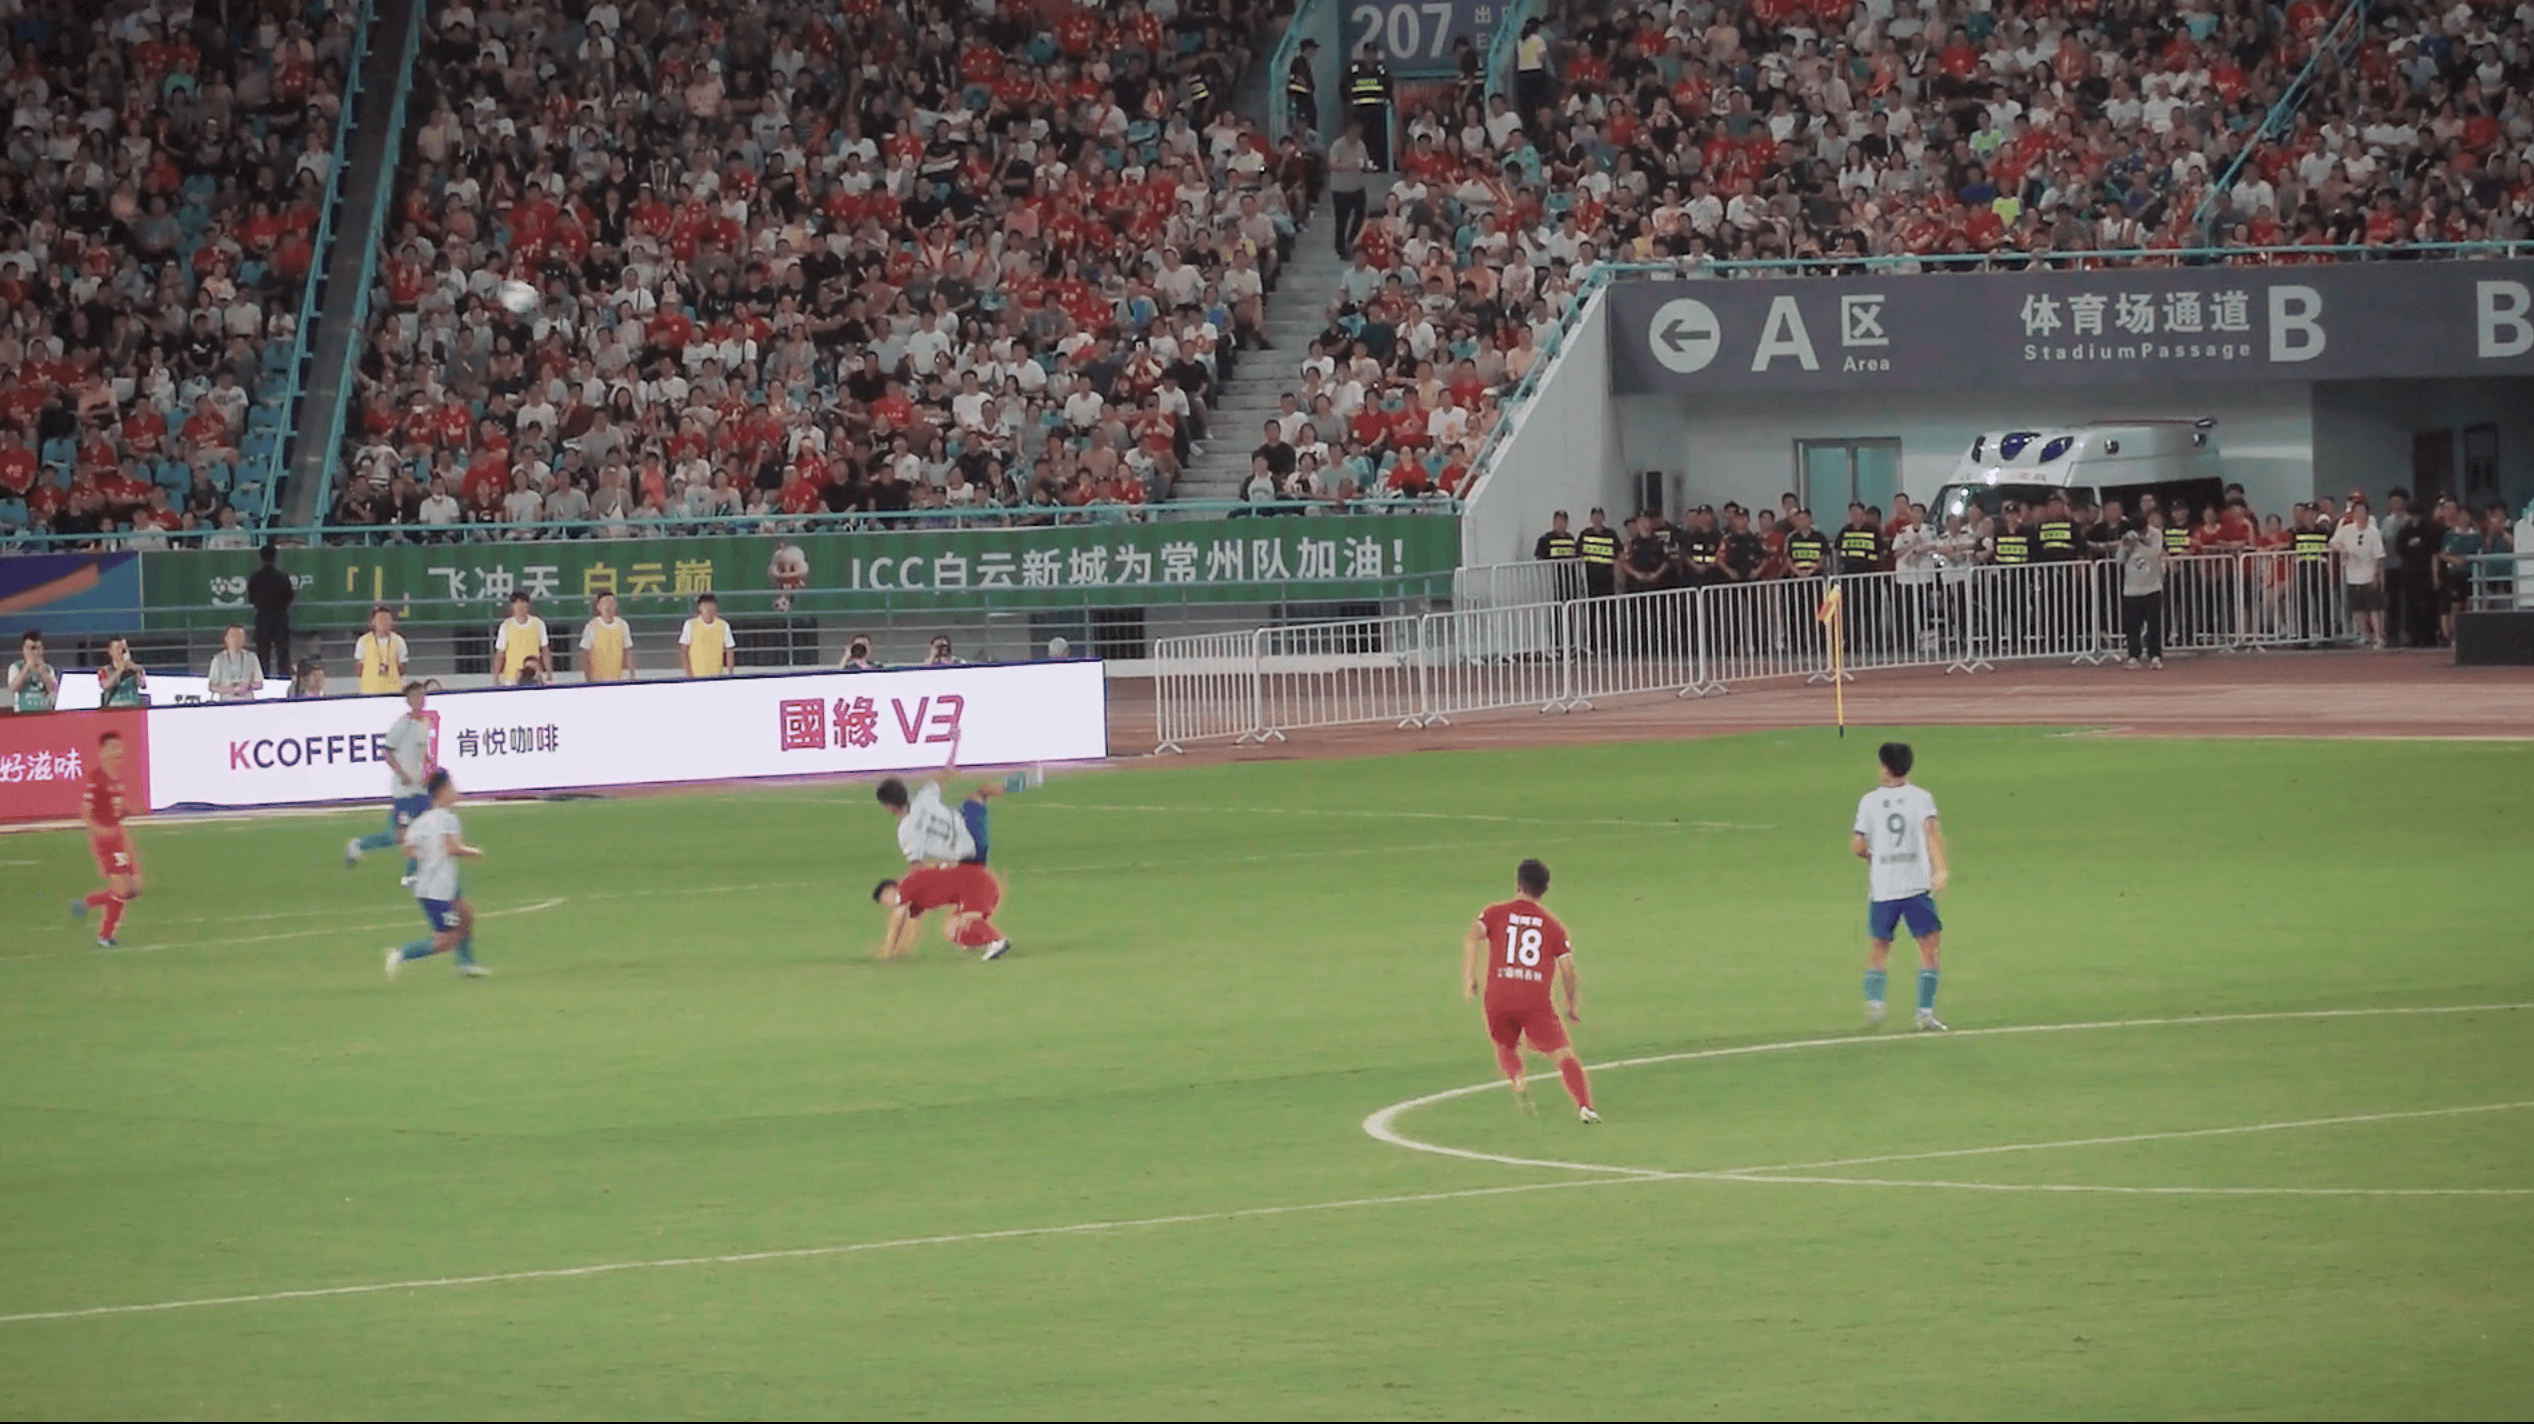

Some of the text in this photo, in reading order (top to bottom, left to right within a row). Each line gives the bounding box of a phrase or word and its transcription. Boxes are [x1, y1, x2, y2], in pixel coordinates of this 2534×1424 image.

[1351, 3, 1453, 60] 207
[1751, 295, 1820, 372] A
[1841, 295, 1889, 346] 区
[2020, 290, 2250, 337] 体育场通道
[2268, 285, 2326, 363] B
[2477, 281, 2534, 358] B
[1843, 356, 1890, 372] Area
[456, 723, 559, 758] 肯悦咖啡
[780, 694, 965, 751] 國緣 V3
[0, 747, 82, 783] 好滋味
[229, 733, 387, 770] KCOFFEE
[1887, 813, 1906, 848] 9
[1506, 925, 1543, 967] 18
